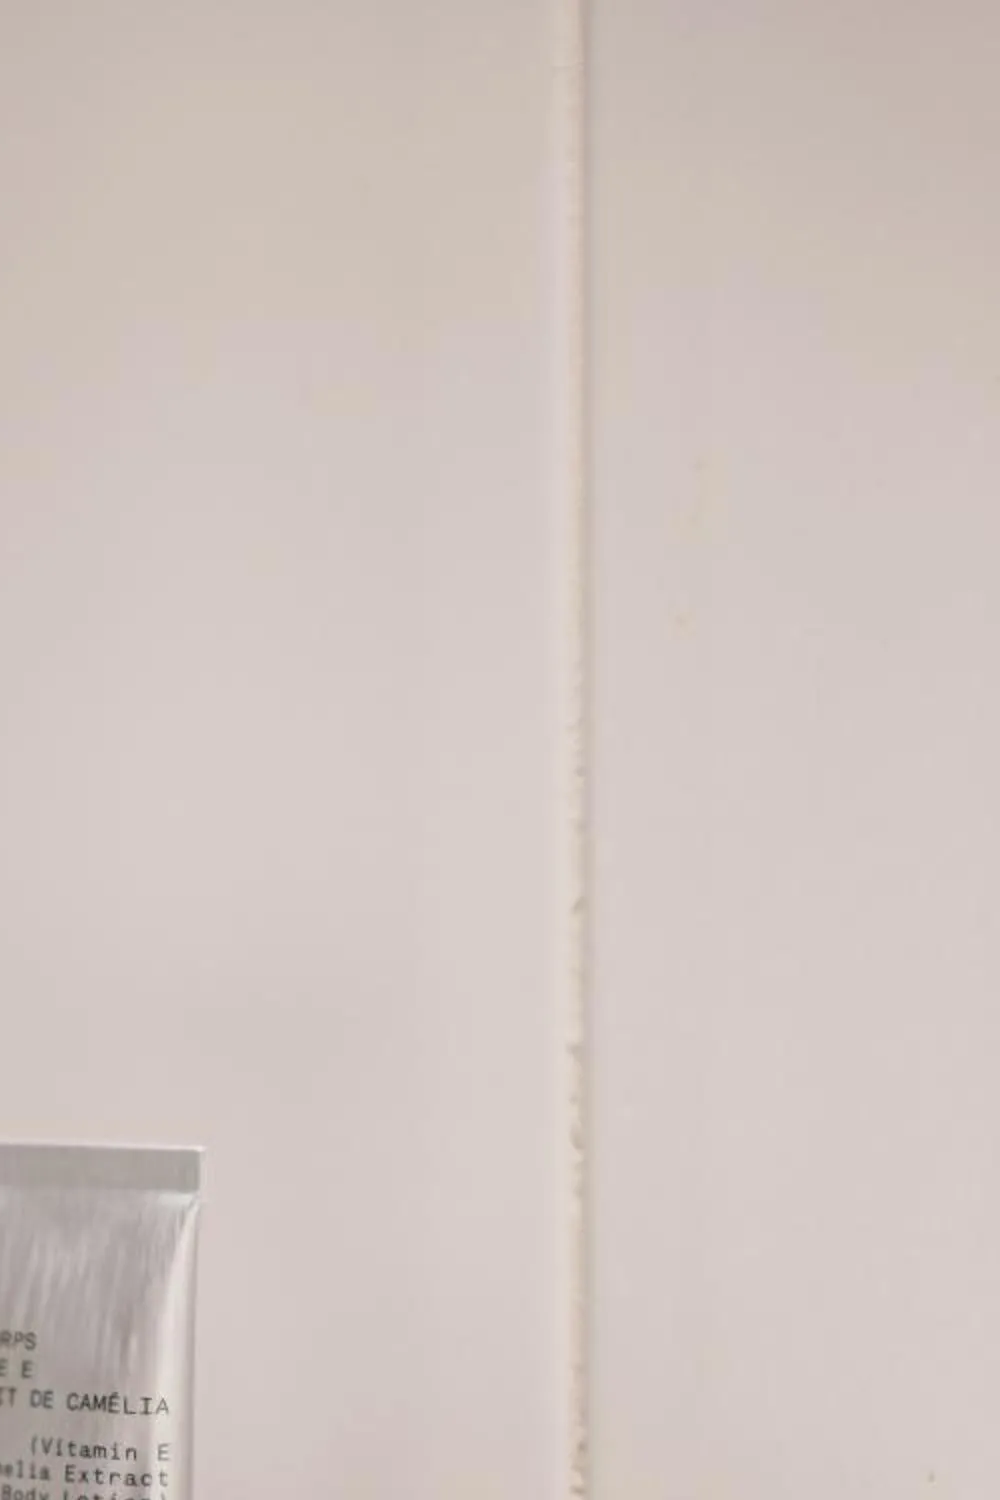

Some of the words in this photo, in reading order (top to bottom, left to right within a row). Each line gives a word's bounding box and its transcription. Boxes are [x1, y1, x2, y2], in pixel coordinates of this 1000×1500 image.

[21, 1360, 34, 1379] E
[30, 1389, 54, 1409] DE
[67, 1392, 170, 1416] CAMÉLIA
[30, 1435, 138, 1462] (Vitamin
[157, 1443, 172, 1462] E
[64, 1467, 169, 1488] Extract
